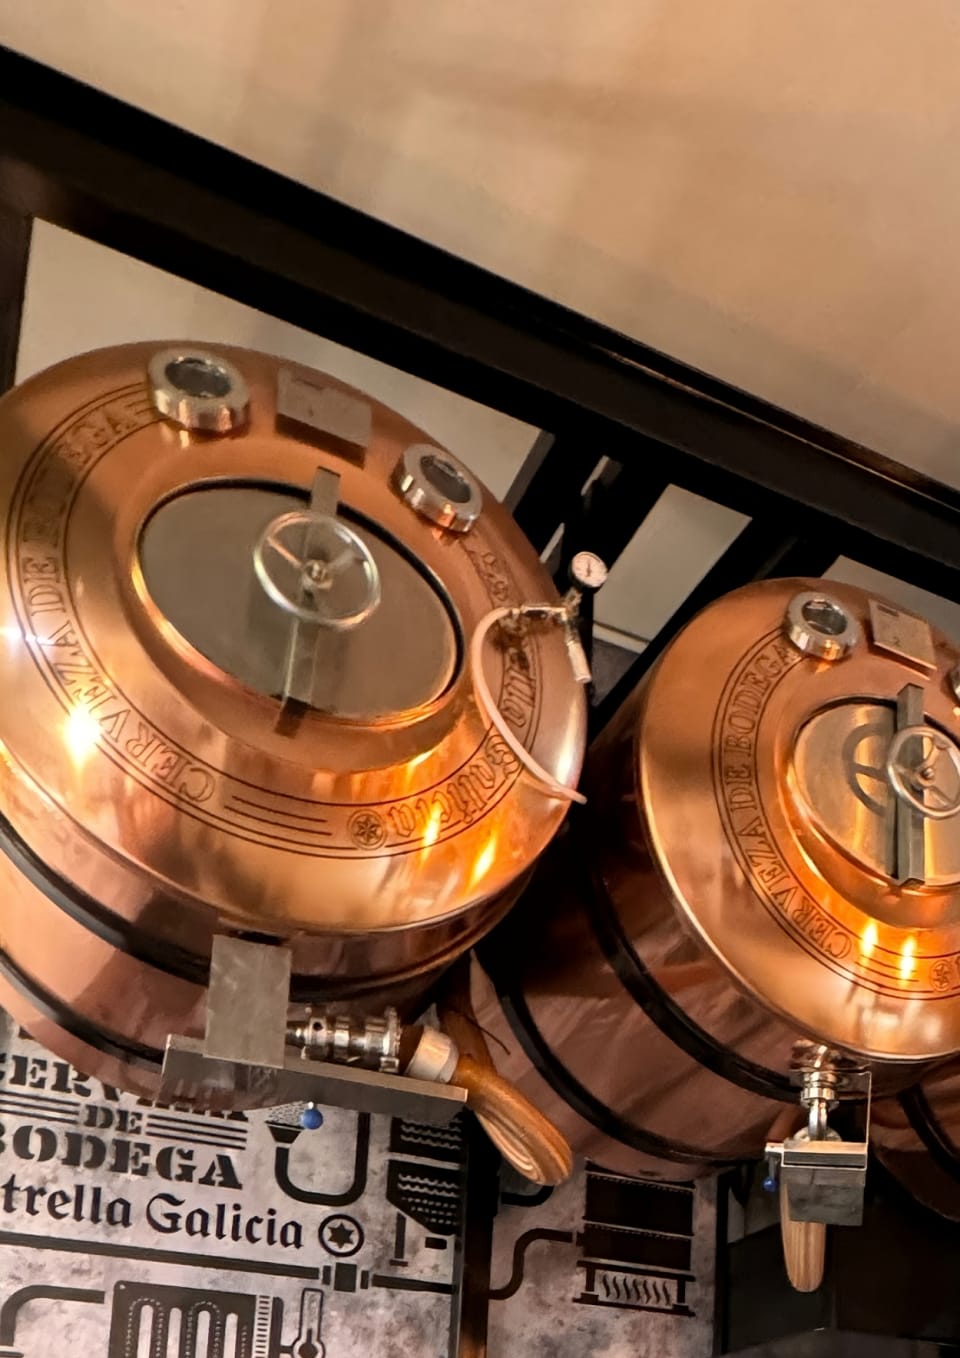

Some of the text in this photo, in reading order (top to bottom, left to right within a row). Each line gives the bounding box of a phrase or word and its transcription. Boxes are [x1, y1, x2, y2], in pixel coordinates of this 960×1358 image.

[23, 556, 66, 617] DE
[39, 620, 216, 802] CERVEZA
[724, 642, 852, 960] CERVEZA DE BODEGA
[83, 1104, 143, 1136] DE
[0, 1122, 243, 1190] ODEGA
[145, 1192, 304, 1250] Galicia
